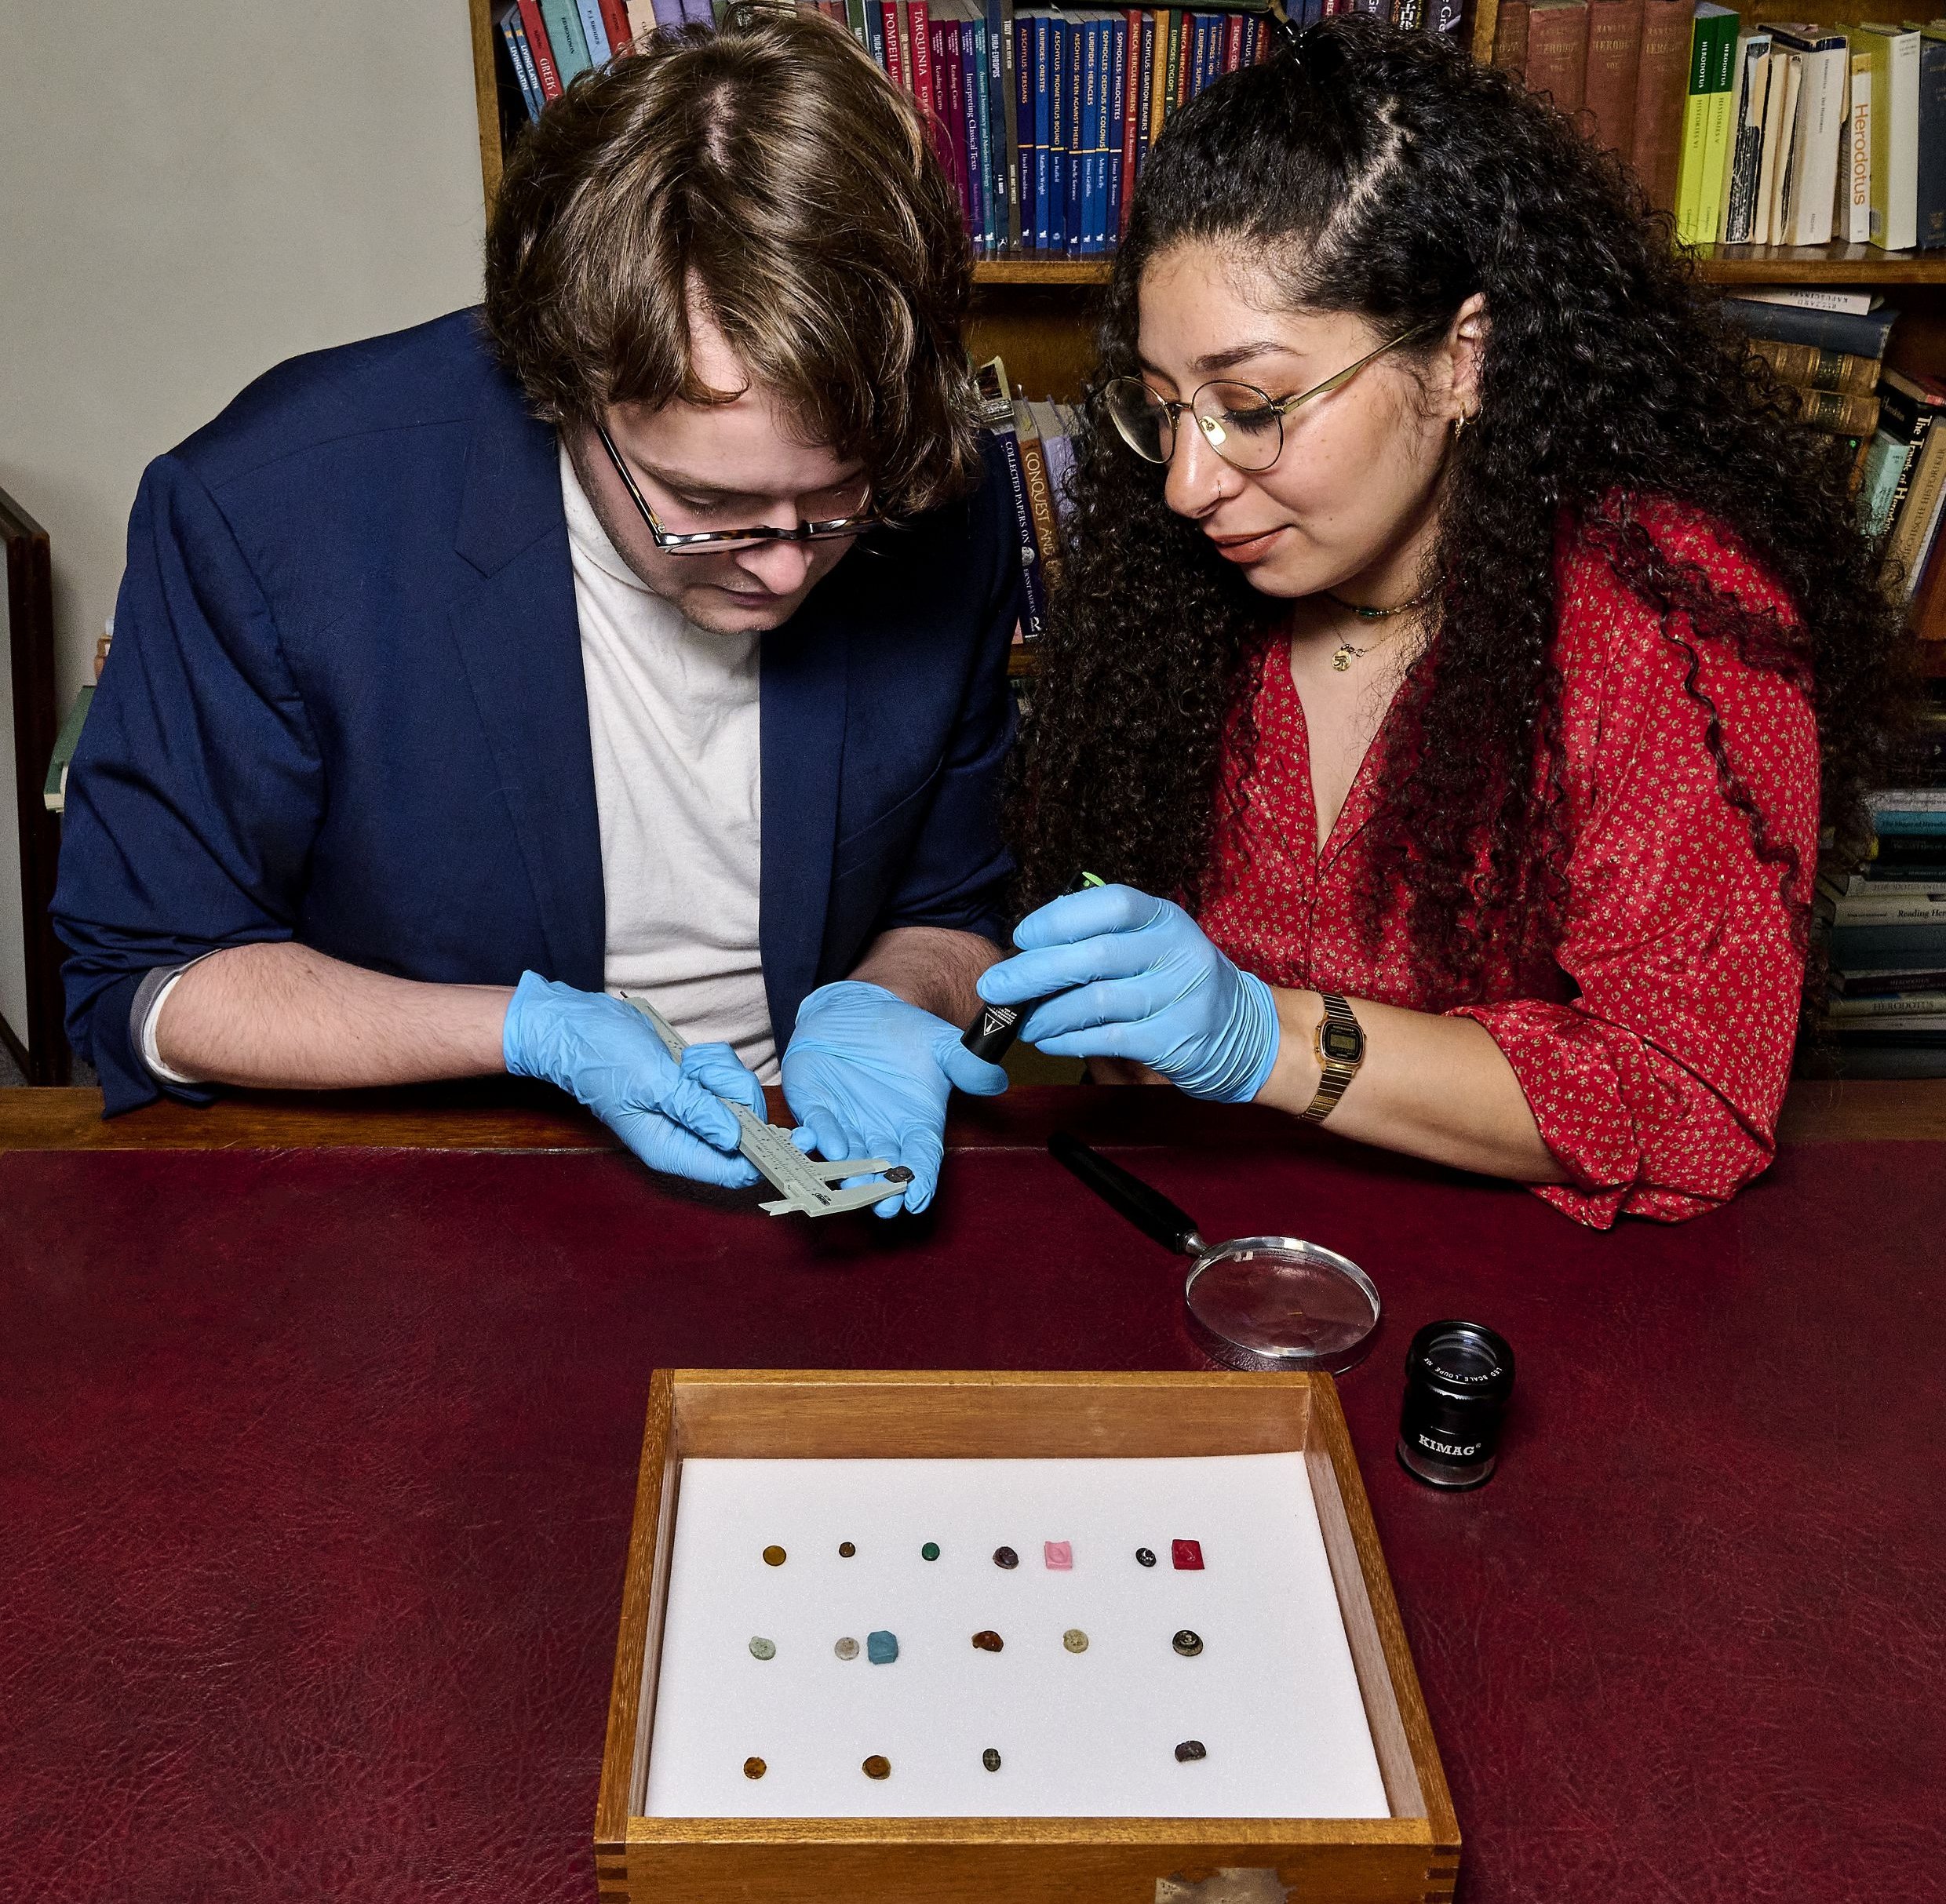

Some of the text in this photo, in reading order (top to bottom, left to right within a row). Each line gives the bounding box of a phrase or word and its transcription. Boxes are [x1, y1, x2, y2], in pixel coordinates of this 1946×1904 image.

[561, 16, 575, 55] EDMONDSON
[591, 20, 600, 46] RHODES
[886, 13, 898, 63] POMPEII
[913, 9, 927, 77] TARQUINIA
[510, 46, 529, 90] LIVING LATIN
[520, 45, 539, 89] LIVING LATIN
[991, 33, 1000, 78] DURA-EUROPOS
[1721, 43, 1730, 86] HERODOTUS
[540, 57, 556, 91] GREEK
[965, 73, 975, 118] Interpreting
[1101, 105, 1106, 114] AT
[1693, 41, 1708, 150] HERODOTUS HISTORIES VI
[968, 119, 978, 150] Classical
[1715, 97, 1725, 137] HISTORIES
[1854, 104, 1869, 206] Herodotus
[1913, 415, 1933, 435] The
[1004, 441, 1021, 492] COLLECTED
[1899, 473, 1907, 485] of
[1015, 493, 1027, 528] PAPERS
[1025, 452, 1050, 523] CONQUEST
[1039, 527, 1055, 555] AND
[1021, 530, 1030, 544] ON
[1022, 568, 1031, 588] ERNST
[1026, 590, 1036, 614] BADIAN
[1897, 909, 1930, 919] Reading
[1423, 1356, 1433, 1367] 10X
[1434, 1367, 1459, 1381] LOUPE
[1490, 1367, 1503, 1378] LED
